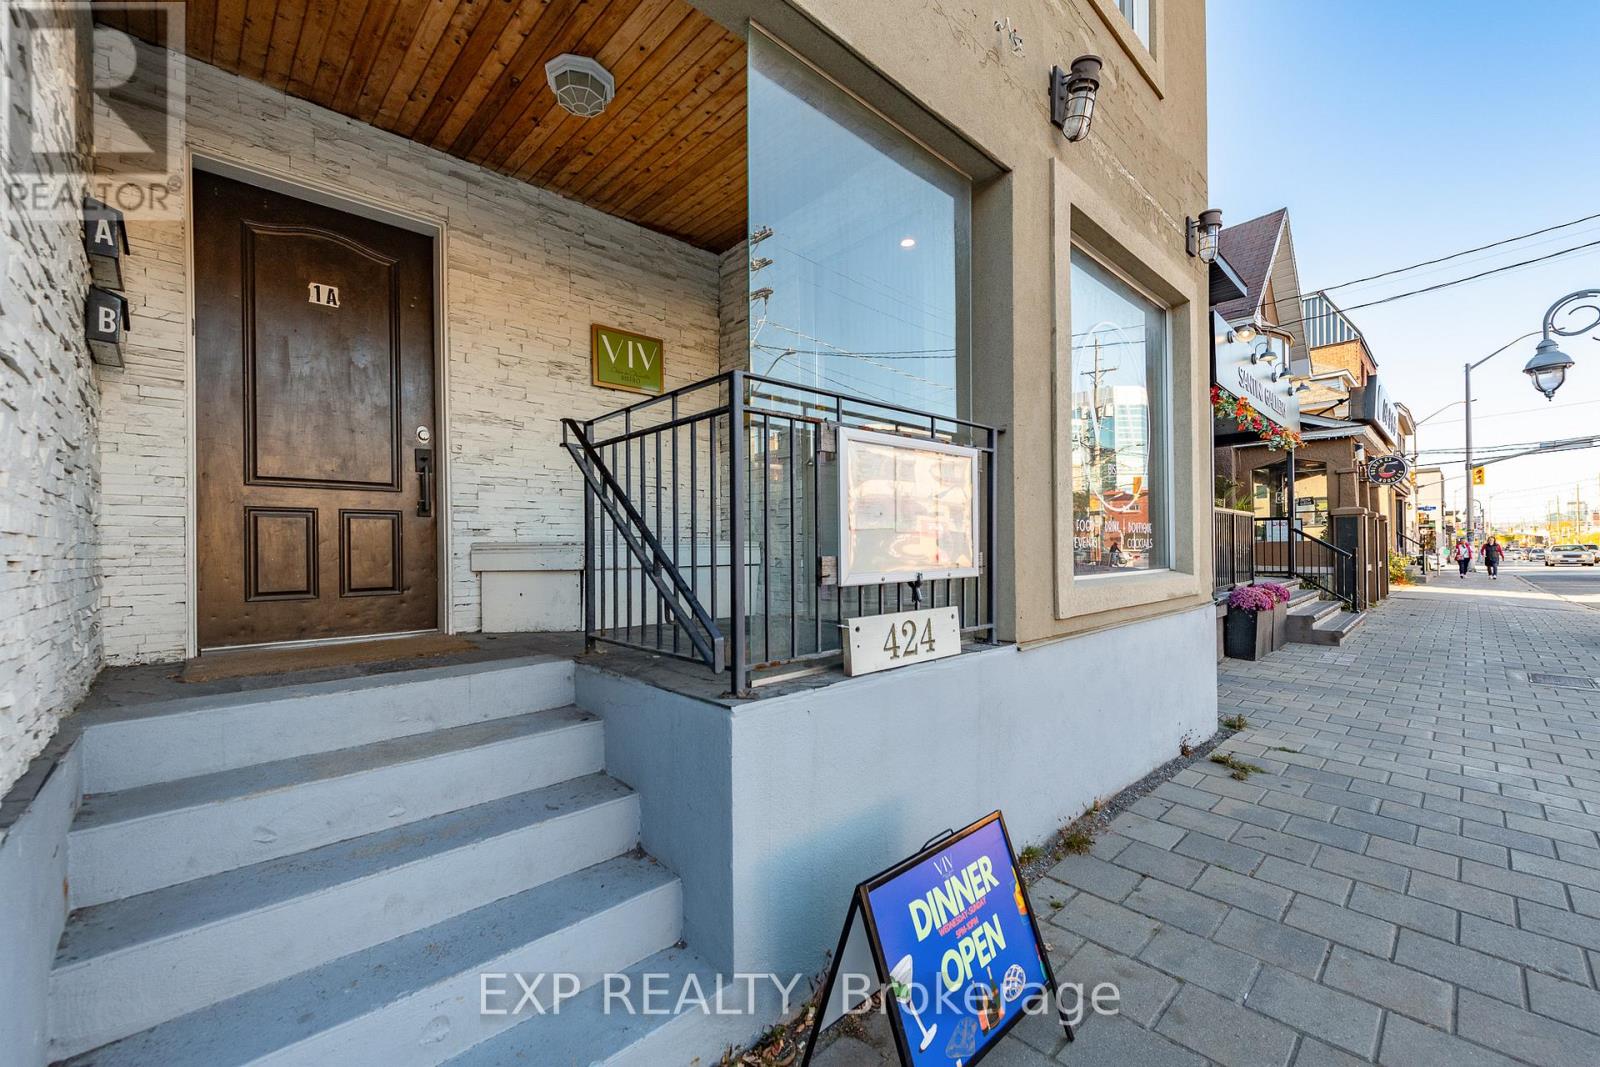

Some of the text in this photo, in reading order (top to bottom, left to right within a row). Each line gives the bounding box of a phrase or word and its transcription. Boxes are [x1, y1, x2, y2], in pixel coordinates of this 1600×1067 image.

[94, 218, 114, 246] A
[313, 284, 338, 306] 1A
[99, 306, 117, 334] B
[601, 334, 658, 371] VIV
[883, 617, 936, 660] 424
[908, 855, 1000, 942] DINNER
[941, 913, 1007, 992] OPEN
